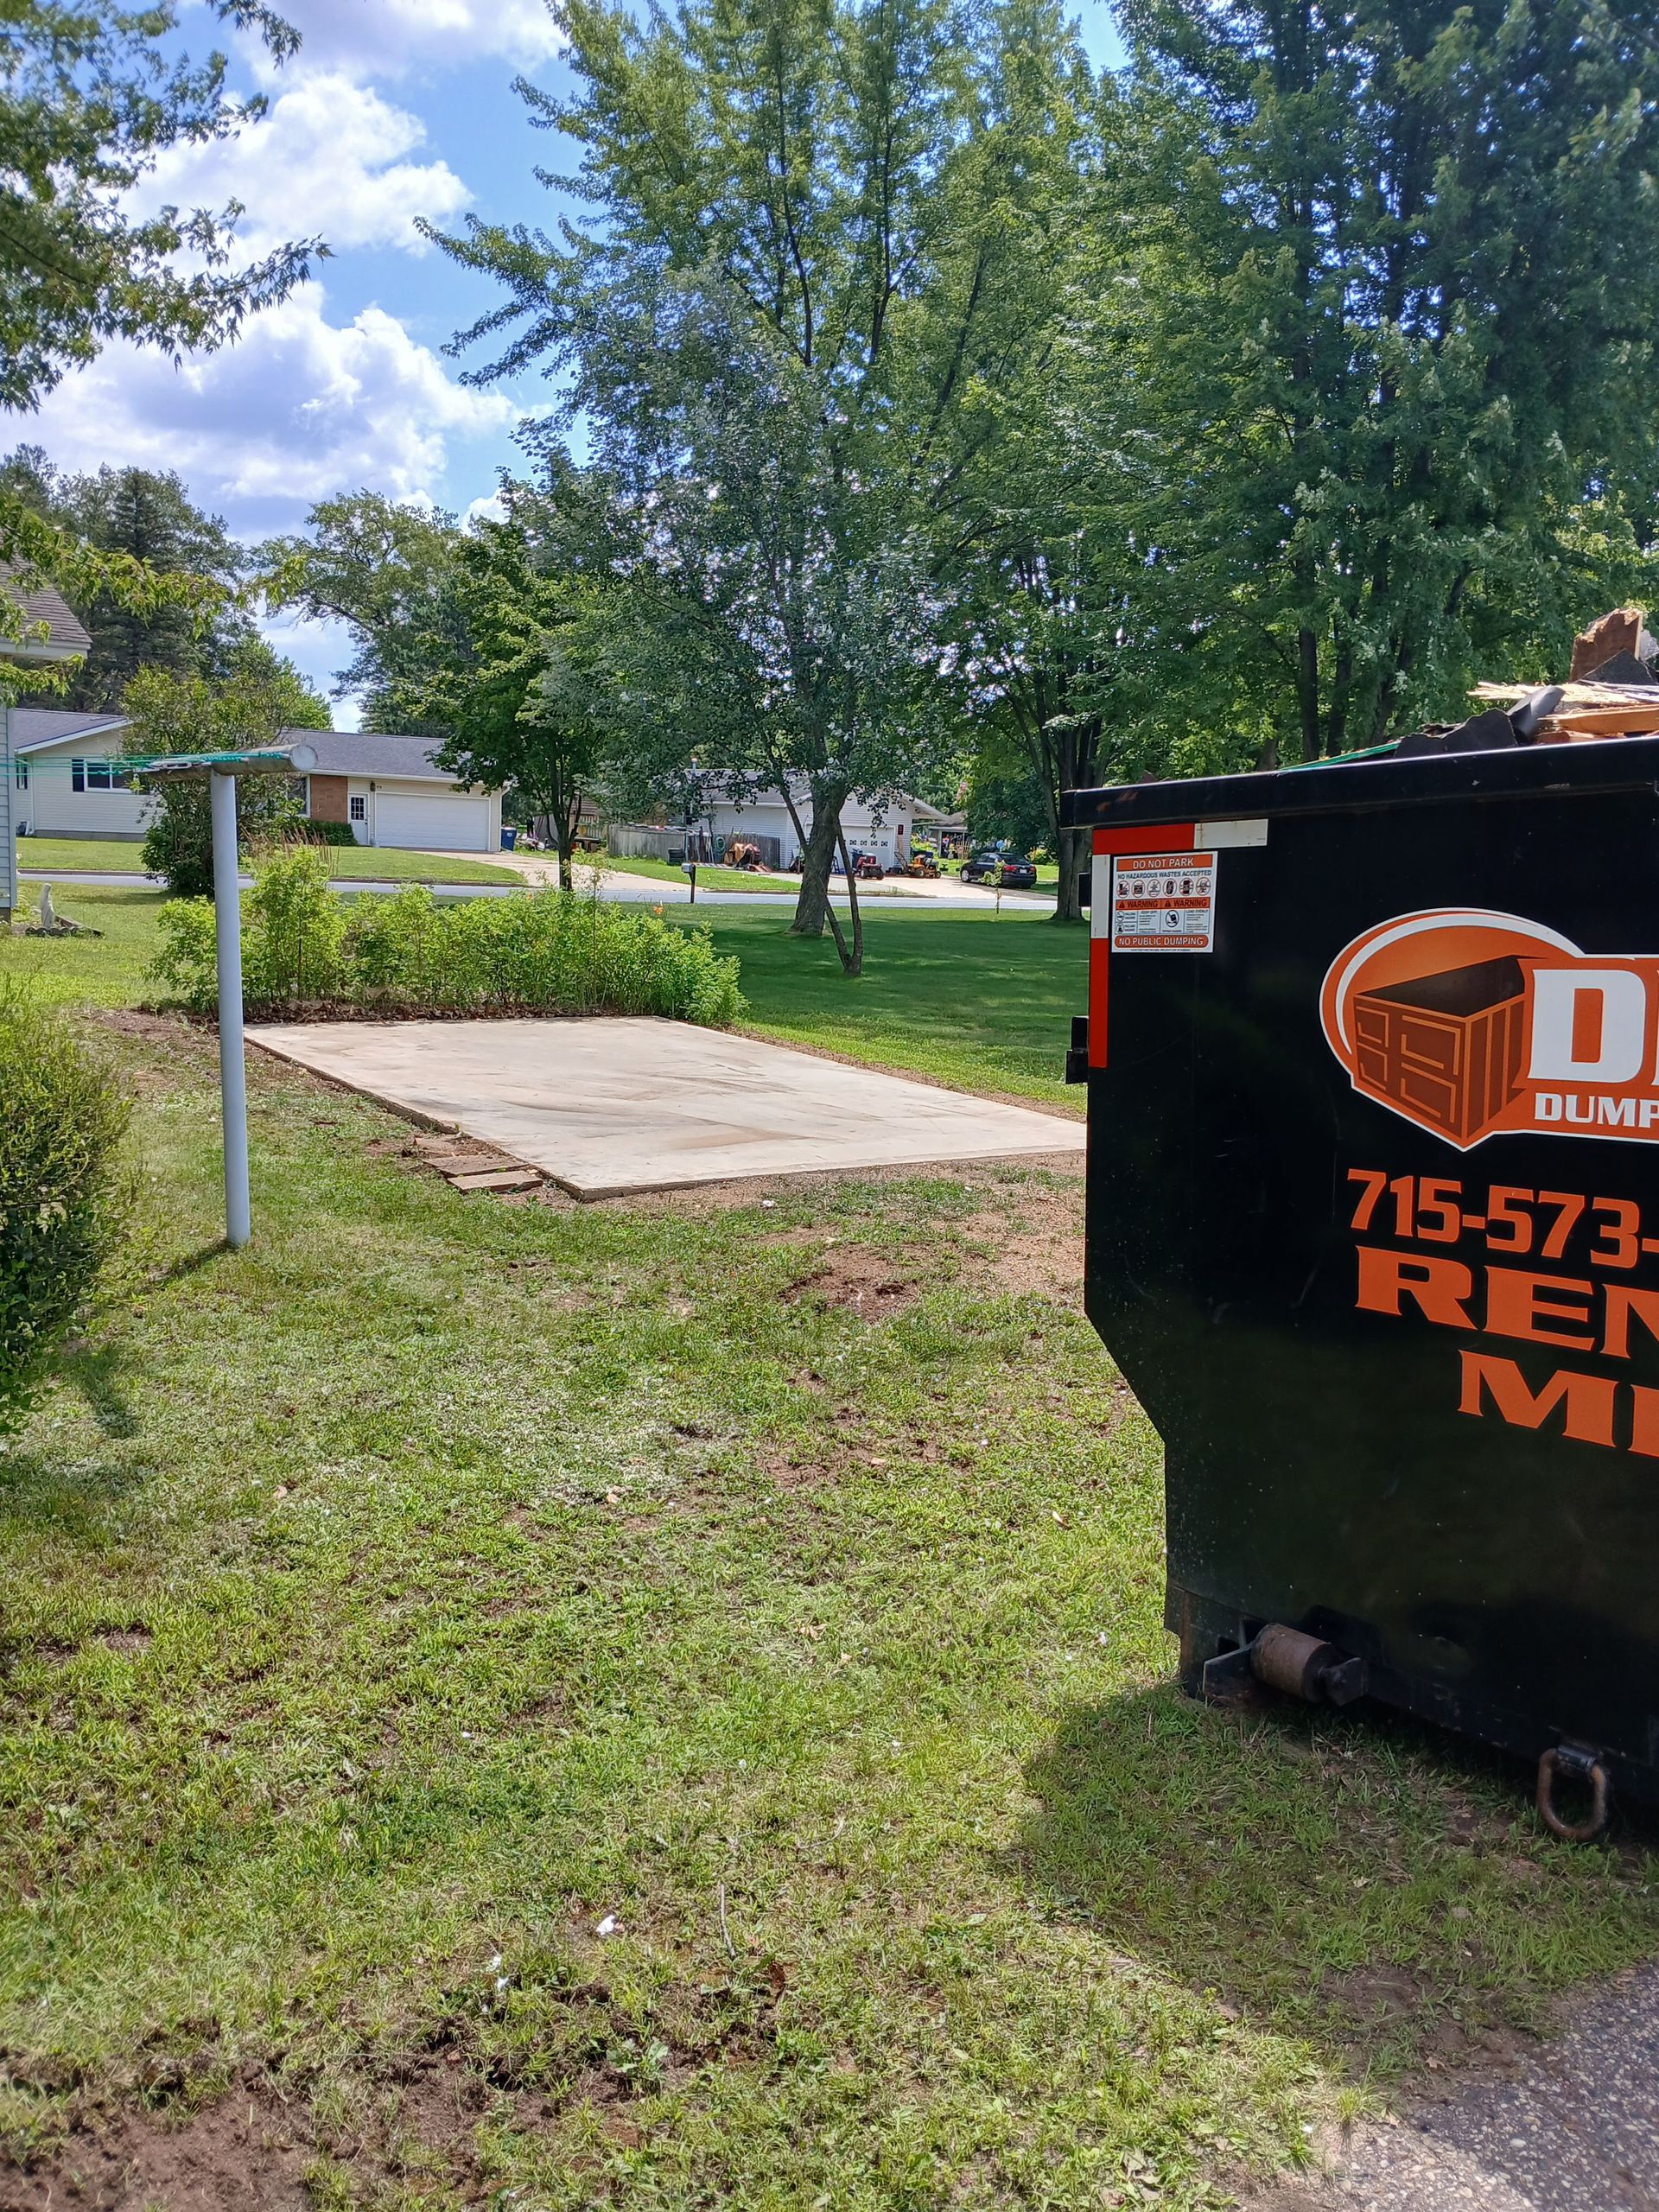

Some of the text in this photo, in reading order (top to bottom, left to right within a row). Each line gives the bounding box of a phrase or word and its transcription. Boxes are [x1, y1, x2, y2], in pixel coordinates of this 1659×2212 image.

[1133, 857, 1194, 869] DO NOT PARK
[1127, 899, 1158, 908] WARNING
[1173, 899, 1207, 907] WARNING
[1132, 937, 1162, 945] PUBLIC
[1164, 937, 1204, 945] DUMPING
[1527, 969, 1659, 1086] D
